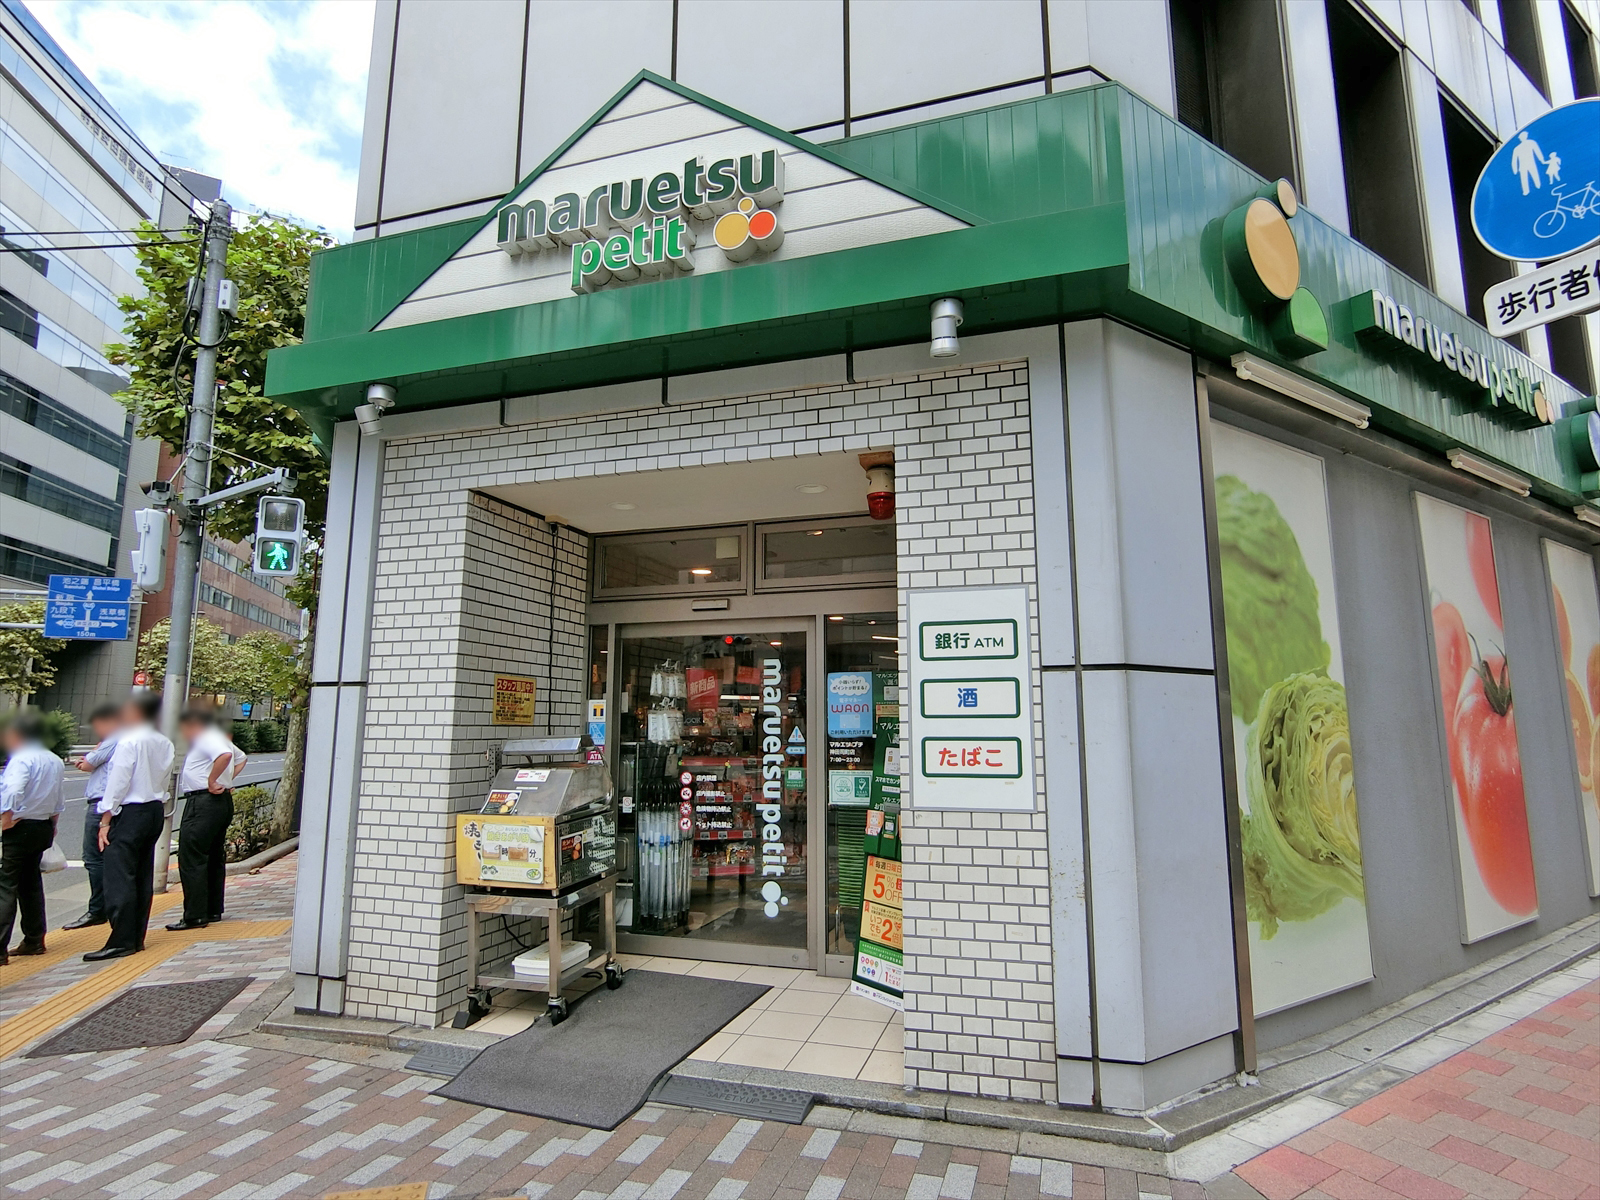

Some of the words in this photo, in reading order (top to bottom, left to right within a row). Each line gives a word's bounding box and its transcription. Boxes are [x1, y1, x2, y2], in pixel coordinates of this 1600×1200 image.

[497, 149, 779, 247] maruetsu
[570, 214, 689, 290] petit
[1372, 288, 1491, 390] maruetsu
[1488, 360, 1537, 418] petit
[50, 607, 77, 615] 九段下
[935, 633, 970, 650] 銀行
[973, 637, 1004, 648] ATM
[689, 676, 716, 695] 新商品
[957, 688, 978, 708] 酒
[762, 658, 785, 799] maruetsu
[938, 746, 1003, 768] たばこ
[755, 803, 787, 877] petit
